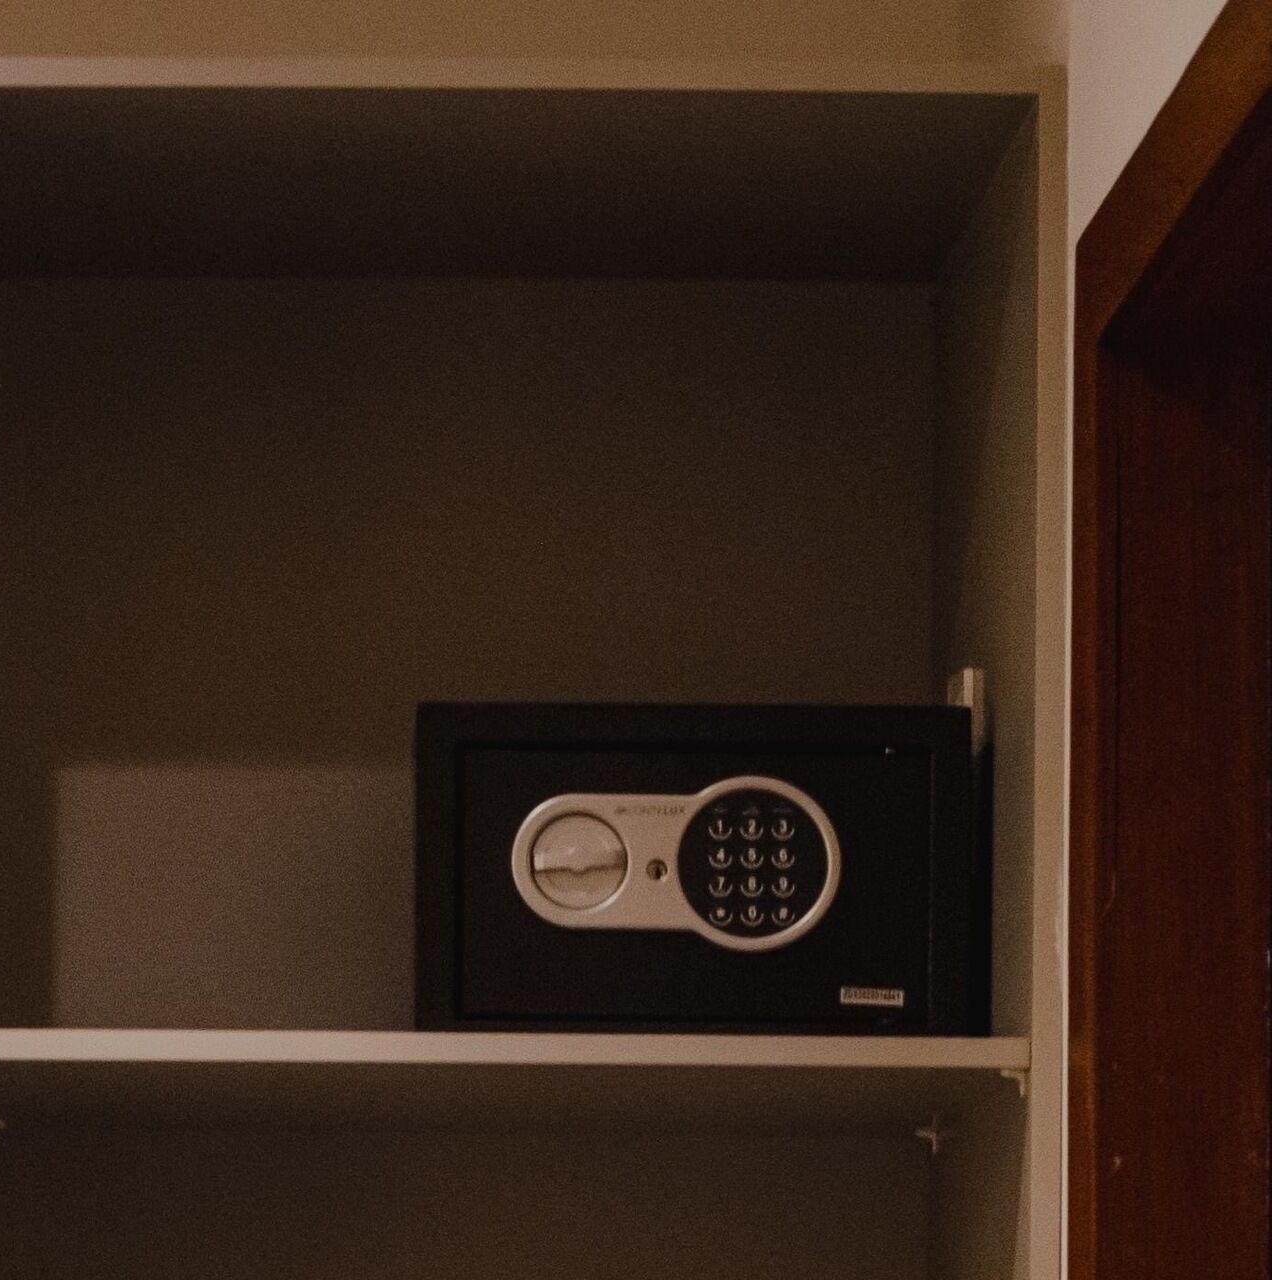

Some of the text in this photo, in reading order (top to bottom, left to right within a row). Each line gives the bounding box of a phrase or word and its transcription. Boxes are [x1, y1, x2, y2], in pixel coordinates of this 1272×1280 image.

[748, 819, 756, 834] 2
[779, 819, 787, 834] 3
[716, 848, 725, 863] 4
[717, 876, 725, 890] 7
